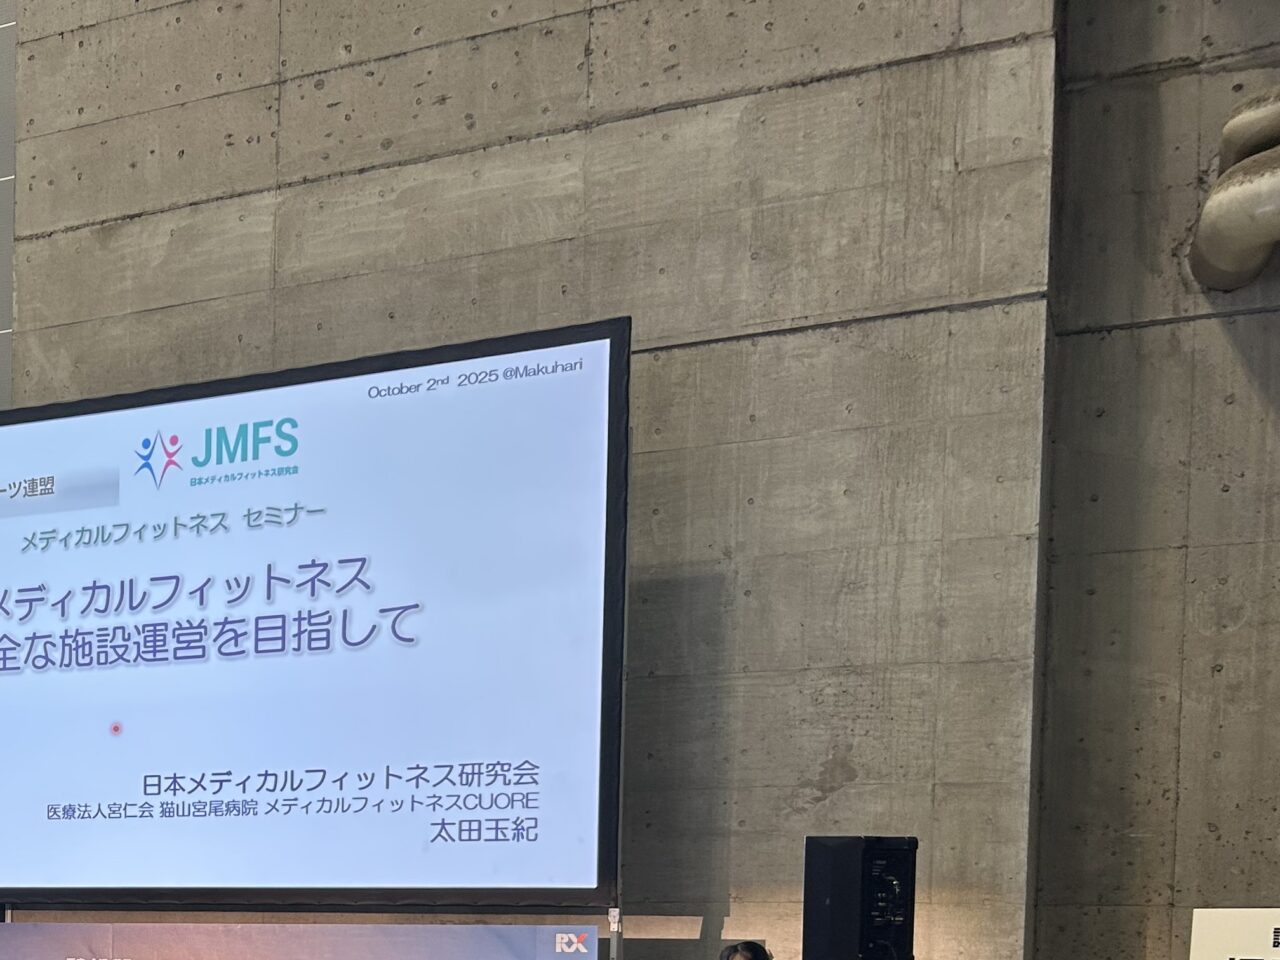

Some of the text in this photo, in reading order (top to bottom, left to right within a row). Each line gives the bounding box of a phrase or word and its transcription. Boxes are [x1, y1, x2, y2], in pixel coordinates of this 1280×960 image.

[368, 358, 583, 400] October 2nd 2025 @Makuhari
[191, 417, 299, 468] JMFS
[190, 465, 299, 487] 日本メディカルフィットネス研究会
[21, 502, 326, 552] メディカルフィットネス セミナー
[142, 759, 540, 798] 日本メディカルフィットネス研究会
[46, 792, 540, 822] 医療法人宮仁会 猫山宮尾病院 メディカルフィットネスCUORE
[429, 817, 539, 844] 太田玉紀
